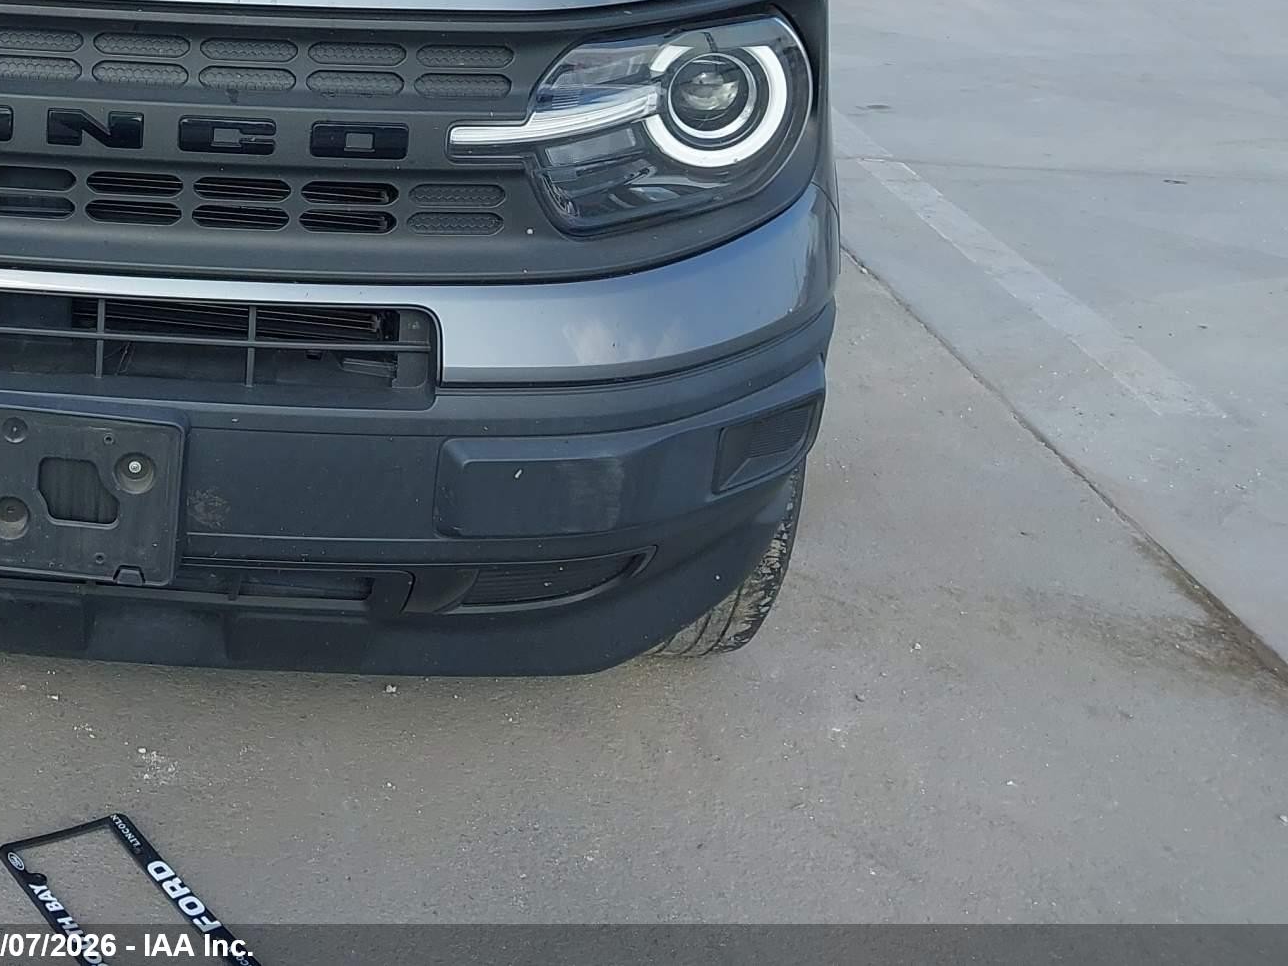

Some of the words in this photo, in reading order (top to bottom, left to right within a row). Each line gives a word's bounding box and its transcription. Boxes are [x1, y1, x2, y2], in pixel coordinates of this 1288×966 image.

[110, 814, 141, 849] LINCOLN
[28, 883, 65, 912] BAY
[147, 860, 222, 933] FORD
